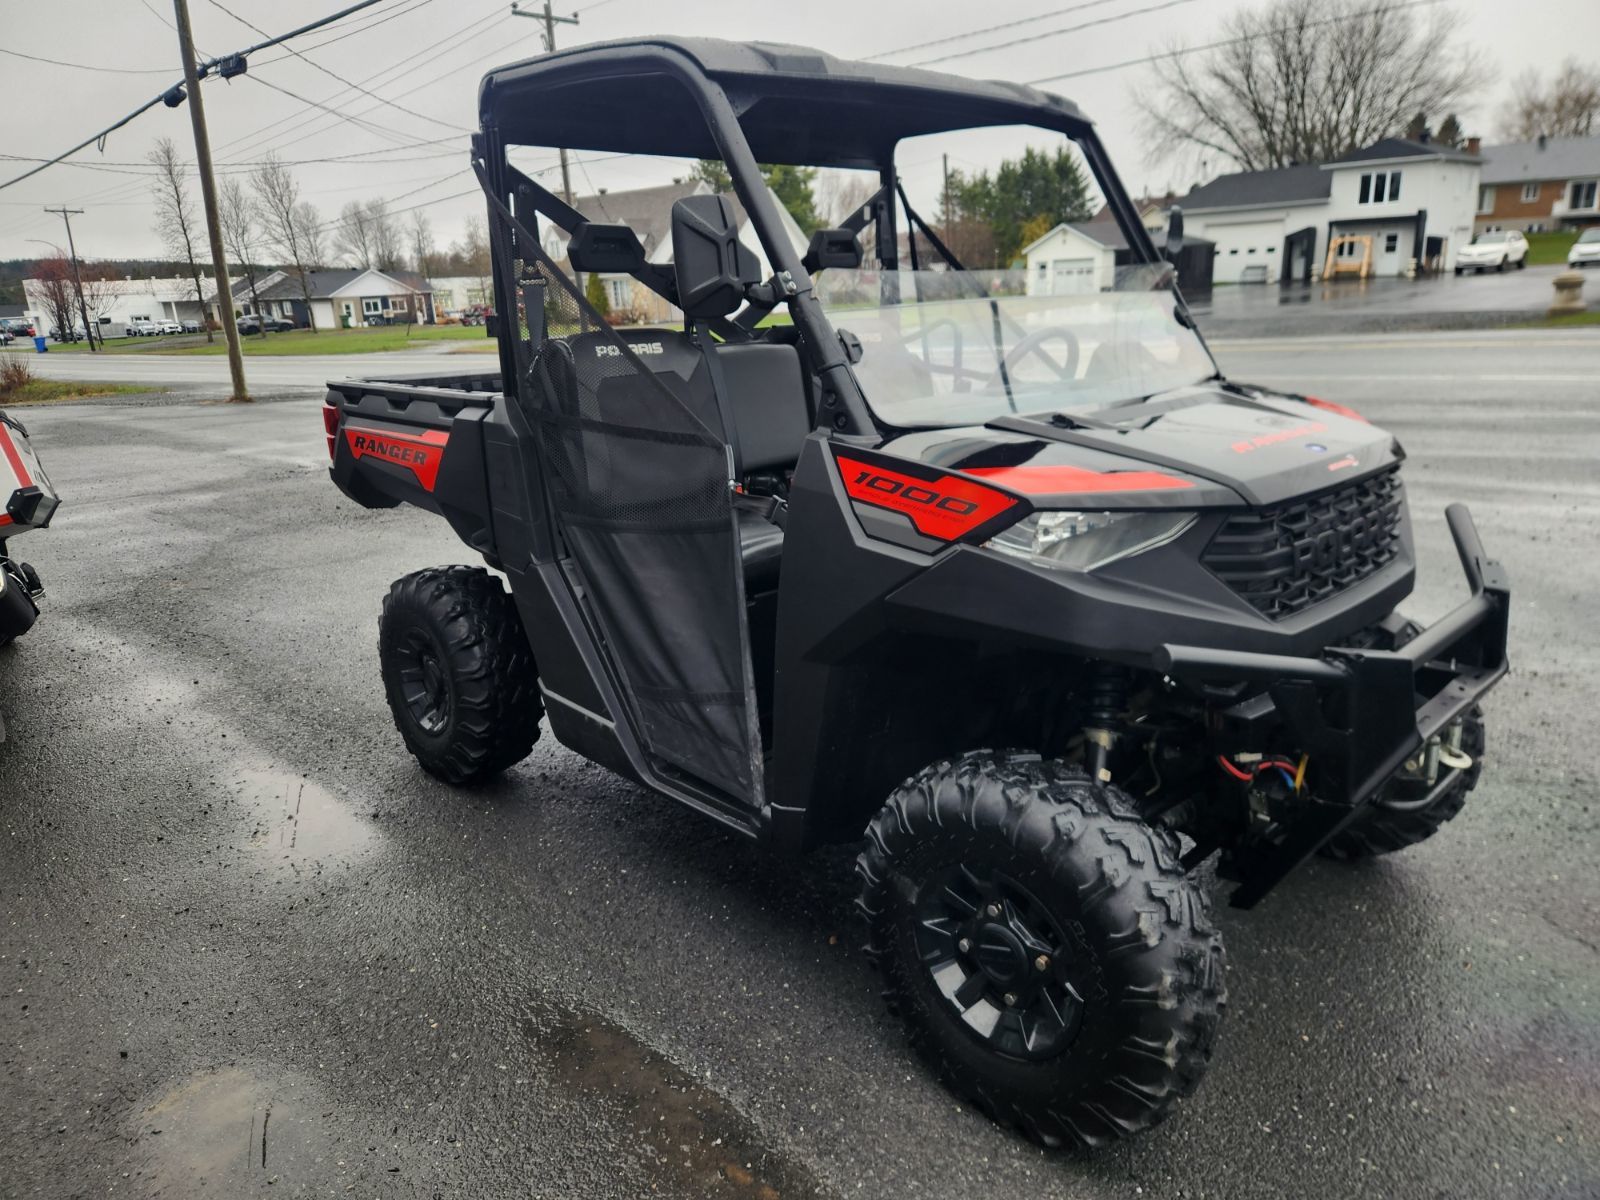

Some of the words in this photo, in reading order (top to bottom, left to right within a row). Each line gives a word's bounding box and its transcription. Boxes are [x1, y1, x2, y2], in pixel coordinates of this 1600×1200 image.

[595, 342, 664, 357] POARIS
[354, 436, 428, 465] RANGER
[854, 471, 979, 516] 1000
